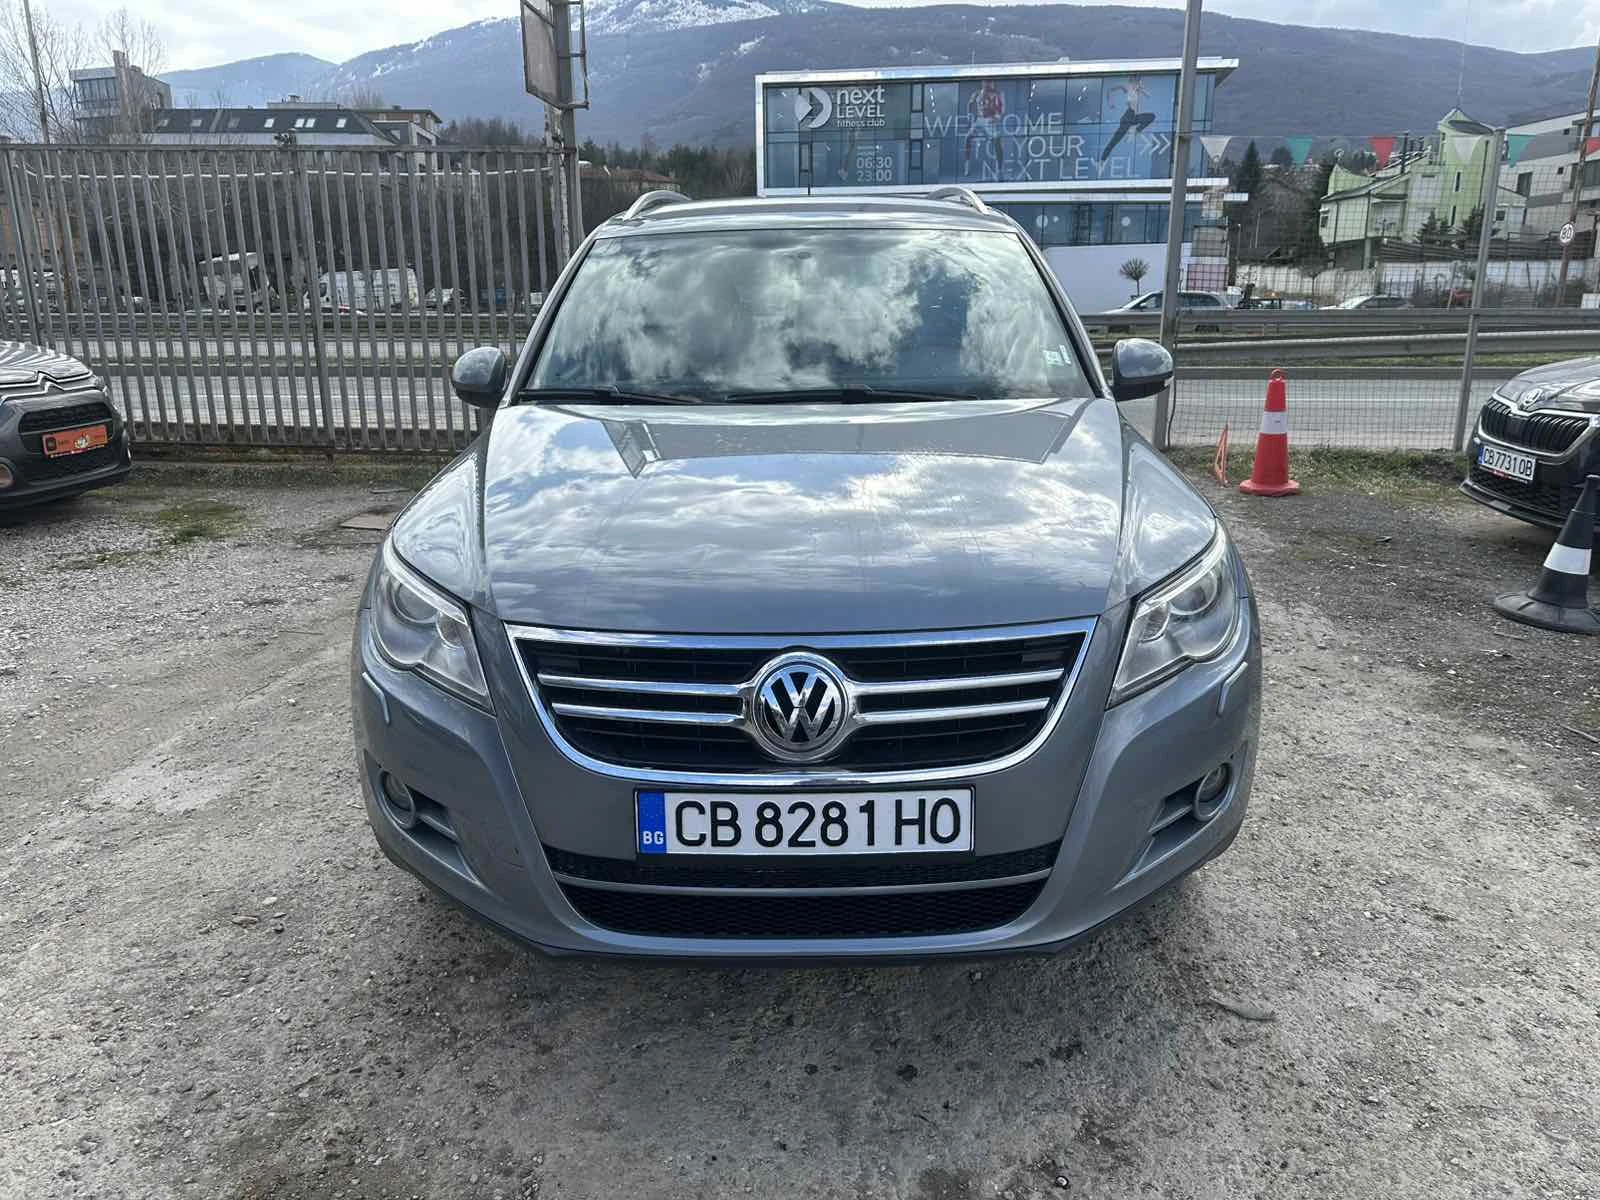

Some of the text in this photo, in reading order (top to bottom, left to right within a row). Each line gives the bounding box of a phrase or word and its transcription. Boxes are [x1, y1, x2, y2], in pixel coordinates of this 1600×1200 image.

[837, 85, 885, 105] next
[837, 104, 885, 119] LEVEL
[837, 117, 886, 128] fitness club
[924, 111, 1064, 137] WECOME
[1012, 134, 1085, 159] YOUR
[856, 156, 893, 169] 06:30
[982, 158, 1051, 181] NEXT
[856, 169, 893, 182] 23:00
[675, 797, 961, 848] CB 8281 HO
[643, 831, 665, 846] BG
